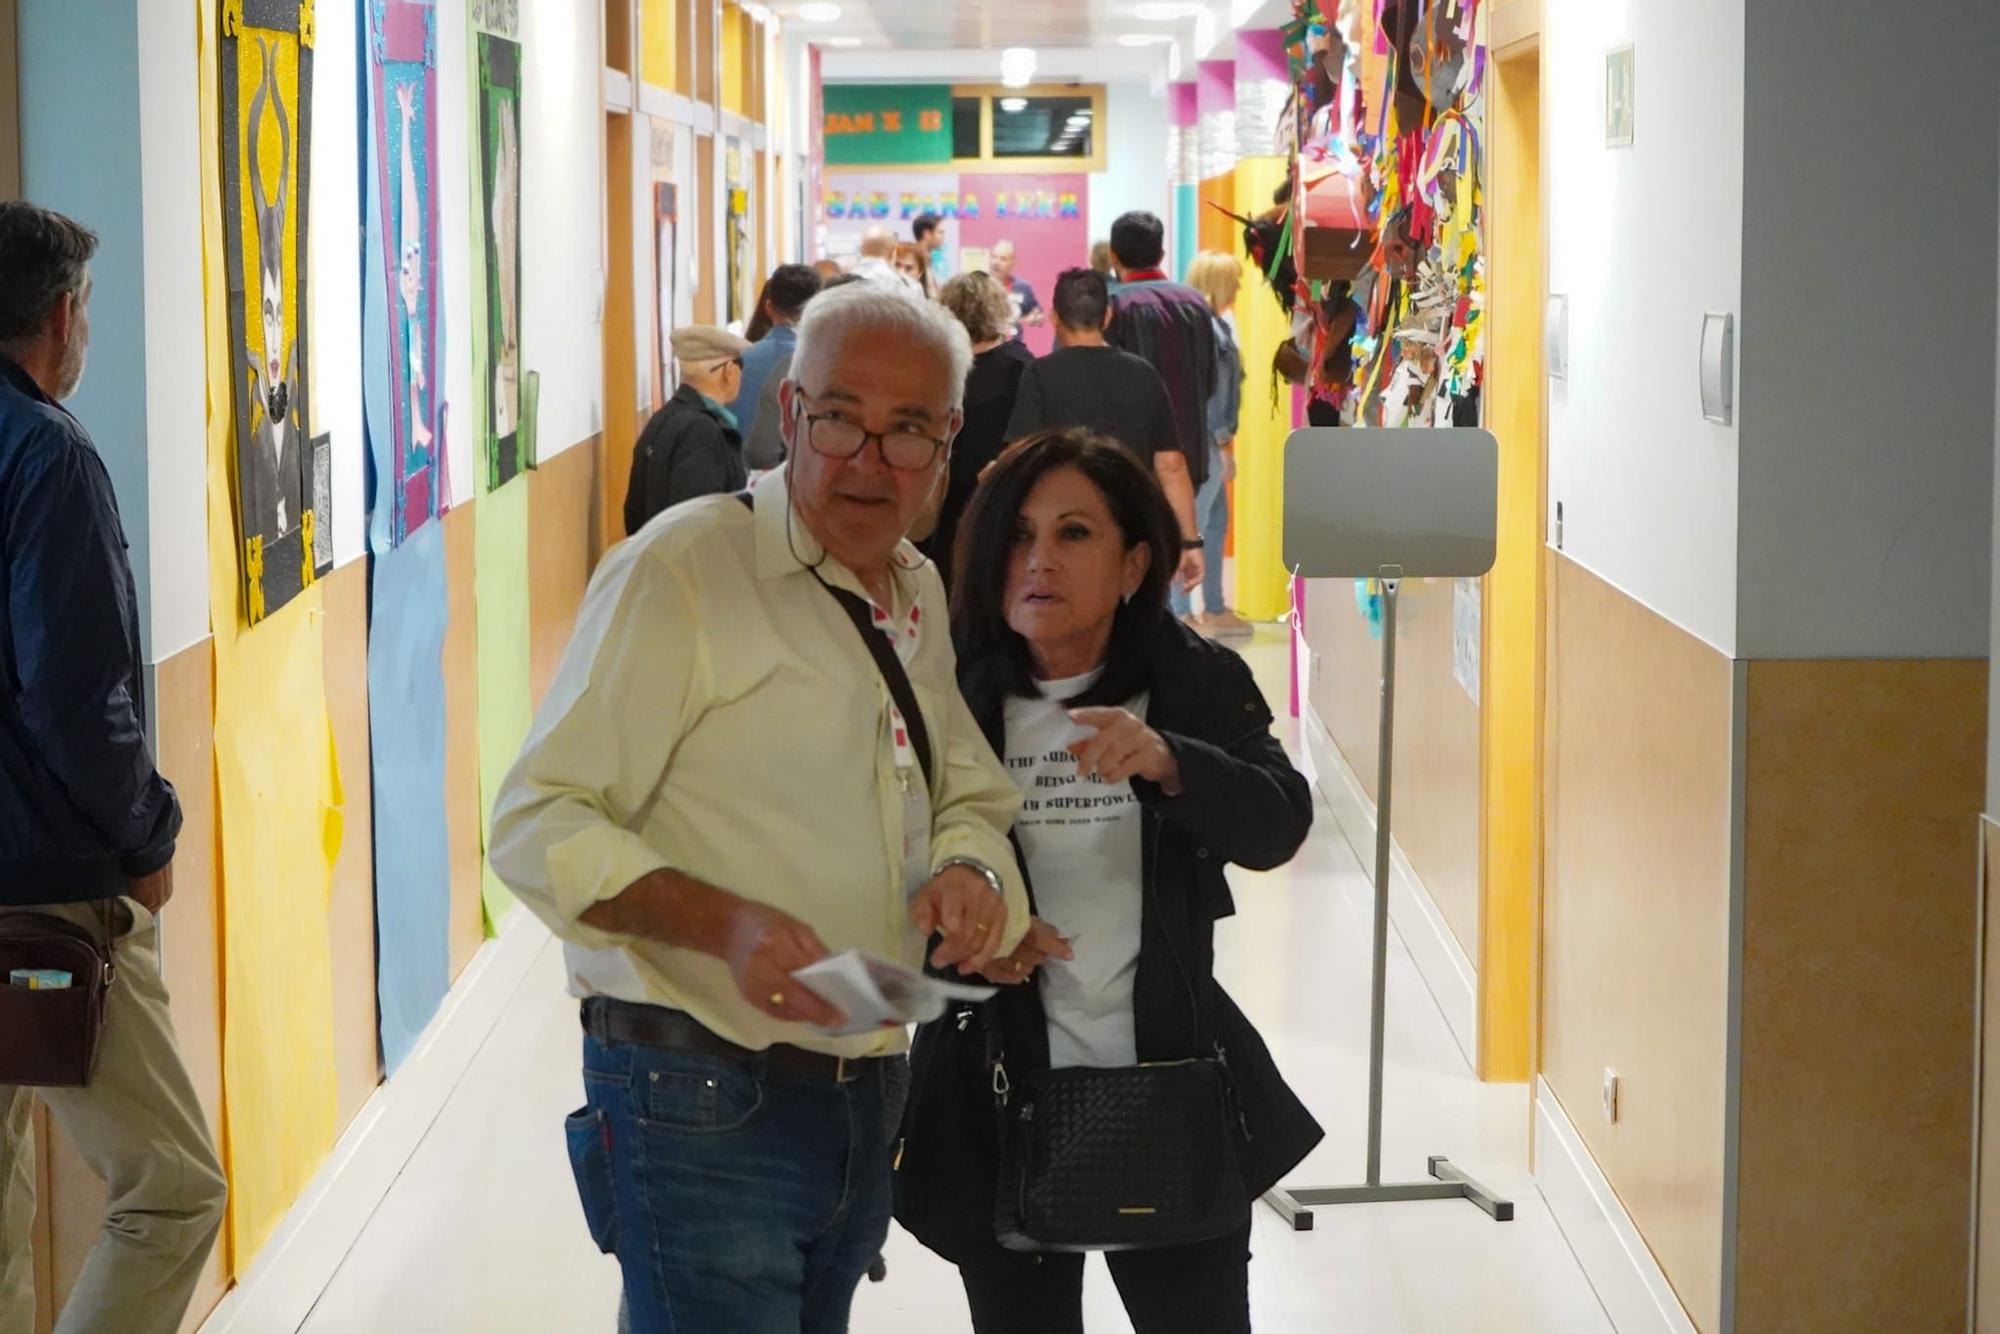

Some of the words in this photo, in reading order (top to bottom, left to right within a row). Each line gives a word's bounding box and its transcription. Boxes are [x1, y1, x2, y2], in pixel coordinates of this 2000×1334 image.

[899, 191, 980, 220] PARA
[1007, 756, 1036, 768] THE
[1035, 774, 1076, 788] BEING
